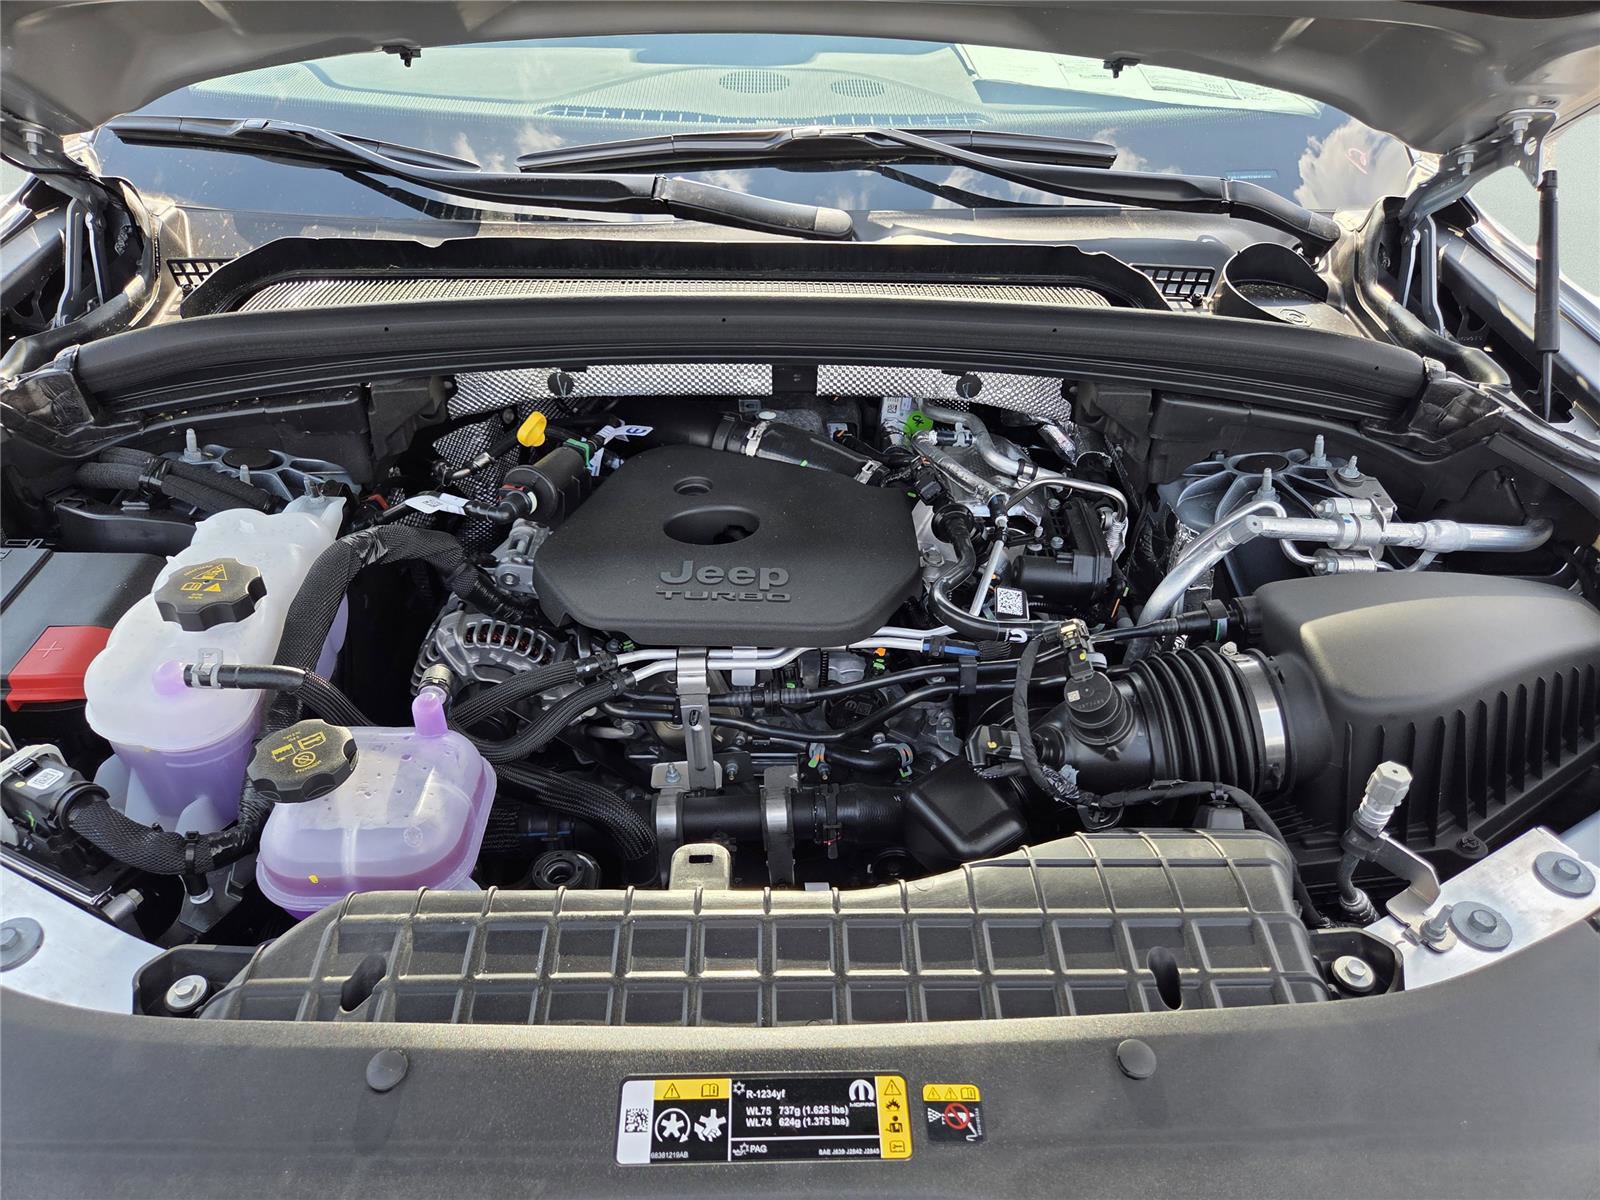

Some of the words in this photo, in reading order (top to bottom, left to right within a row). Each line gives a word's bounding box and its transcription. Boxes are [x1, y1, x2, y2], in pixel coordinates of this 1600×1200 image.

[660, 560, 789, 591] Jeep
[656, 590, 791, 602] TURBO
[746, 1089, 786, 1100] R-1234yf
[746, 1106, 772, 1116] WL75
[779, 1106, 801, 1117] 737g
[802, 1105, 830, 1117] (1.625
[831, 1105, 849, 1116] lbs)
[746, 1117, 772, 1127] WL74
[779, 1117, 801, 1128] 624g
[802, 1117, 831, 1128] (1.375
[831, 1117, 850, 1127] lbs)
[750, 1145, 768, 1153] PAG
